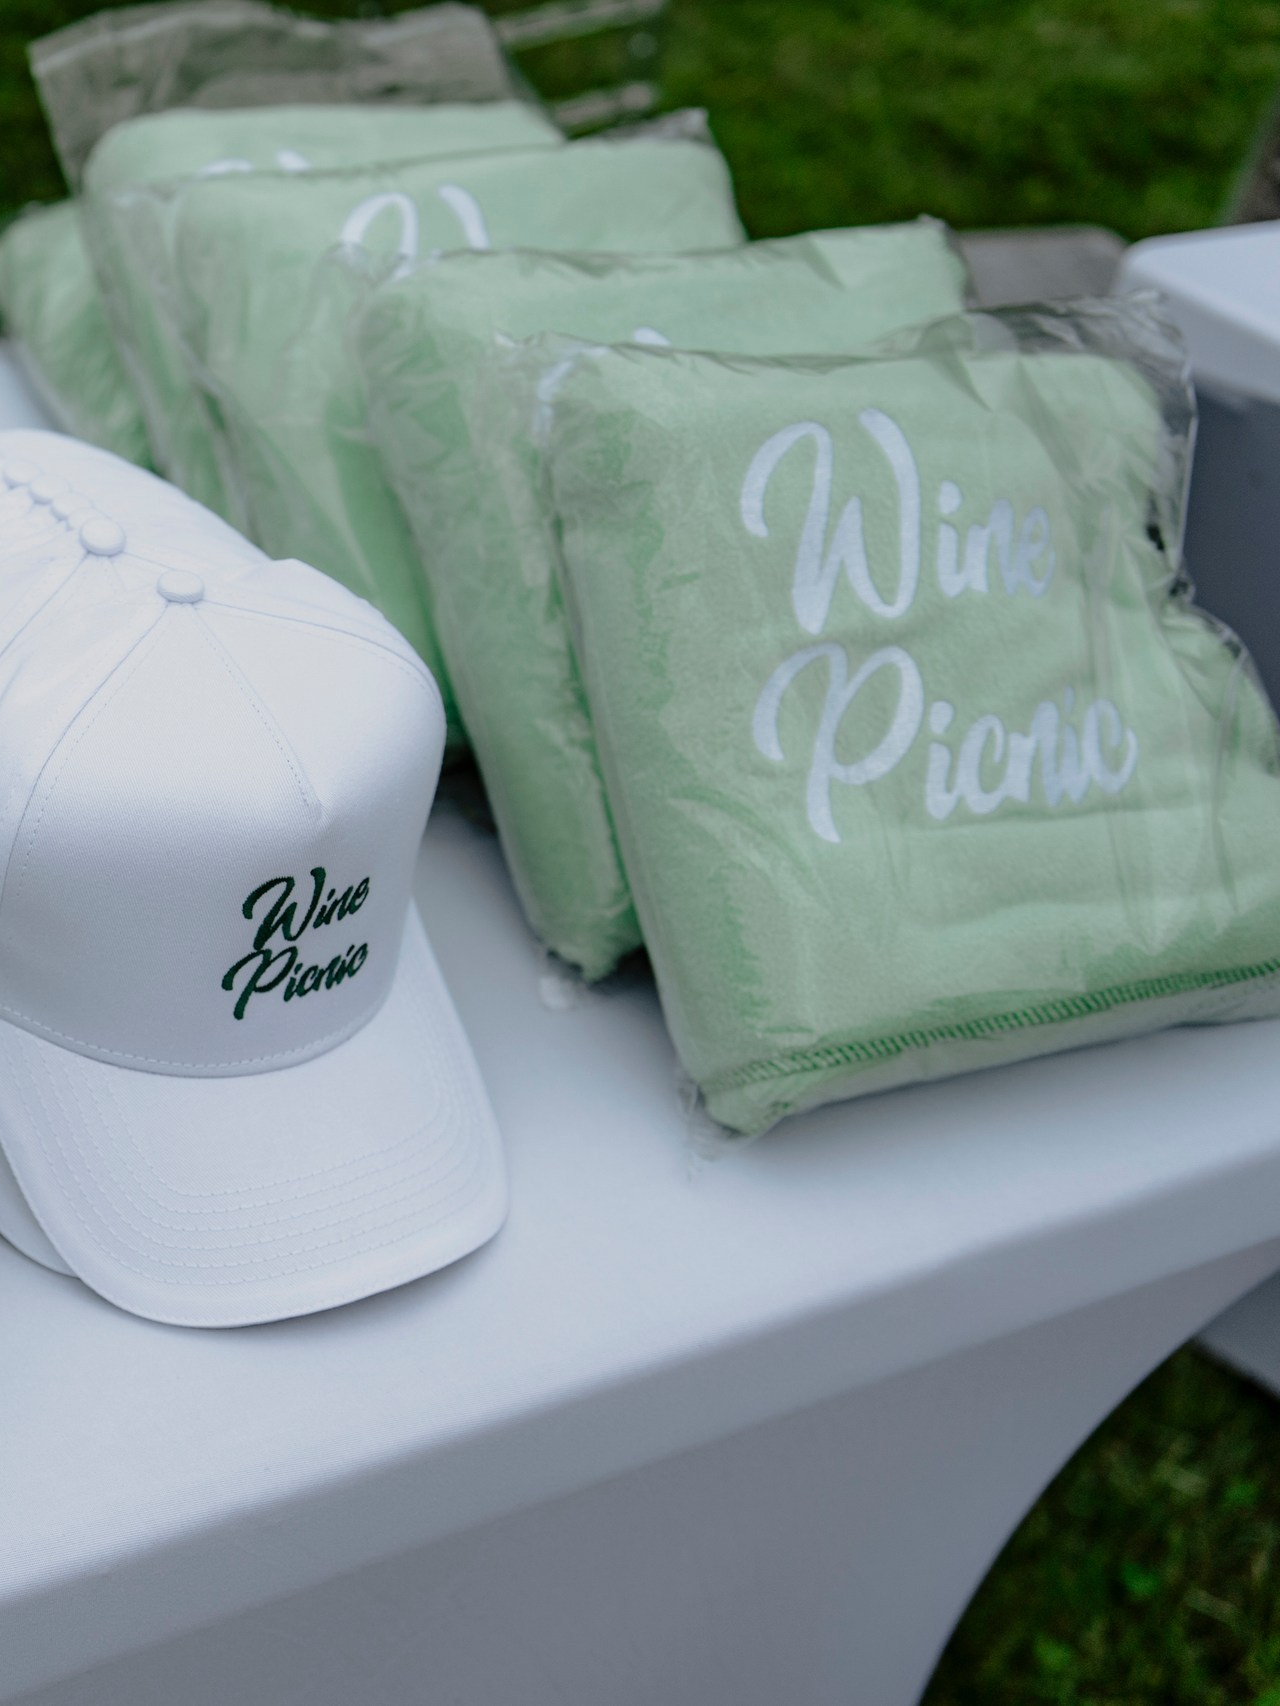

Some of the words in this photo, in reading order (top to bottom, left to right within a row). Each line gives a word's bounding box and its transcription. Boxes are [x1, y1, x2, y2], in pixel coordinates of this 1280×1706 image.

[740, 408, 1055, 635] Wine
[752, 643, 1138, 843] Picnic
[242, 867, 370, 950] Wine
[221, 943, 368, 1020] Picnic
